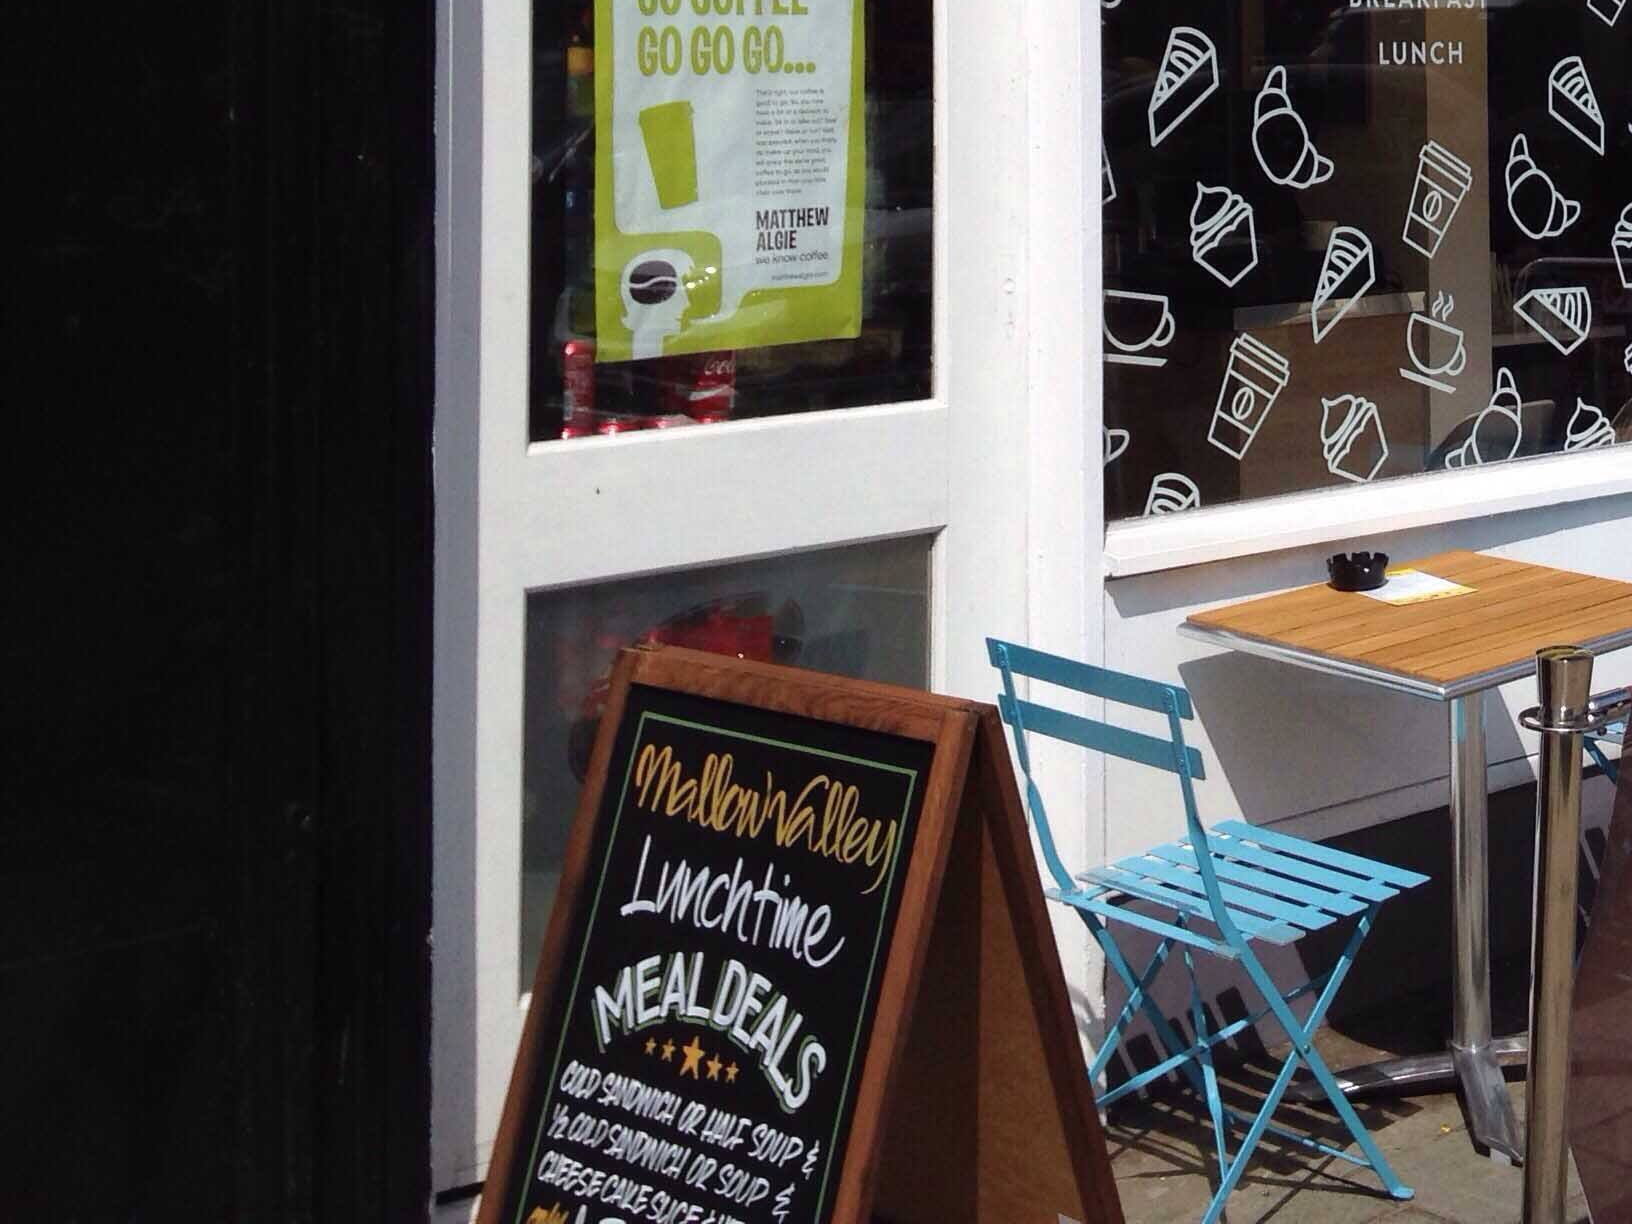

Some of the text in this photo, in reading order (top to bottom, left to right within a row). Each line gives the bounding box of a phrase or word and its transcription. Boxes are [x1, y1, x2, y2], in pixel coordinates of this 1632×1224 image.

[637, 24, 816, 76] GO GO GO...
[1379, 41, 1463, 65] LUNCH
[756, 206, 829, 230] MATTHEW
[756, 230, 797, 252] ALGIE
[765, 774, 897, 895] Valley
[620, 835, 846, 968] Lunchtime
[592, 951, 827, 1114] MEAL DEALS
[560, 1059, 601, 1099] COLD
[598, 1072, 682, 1126] SANDWICH
[678, 1101, 707, 1137] OR
[700, 1108, 752, 1151] HALF
[748, 1124, 803, 1167] SOUP
[567, 1111, 610, 1148] COLD
[604, 1124, 691, 1180] SANDWICH
[686, 1154, 717, 1191] OR
[714, 1164, 771, 1207] SOUP
